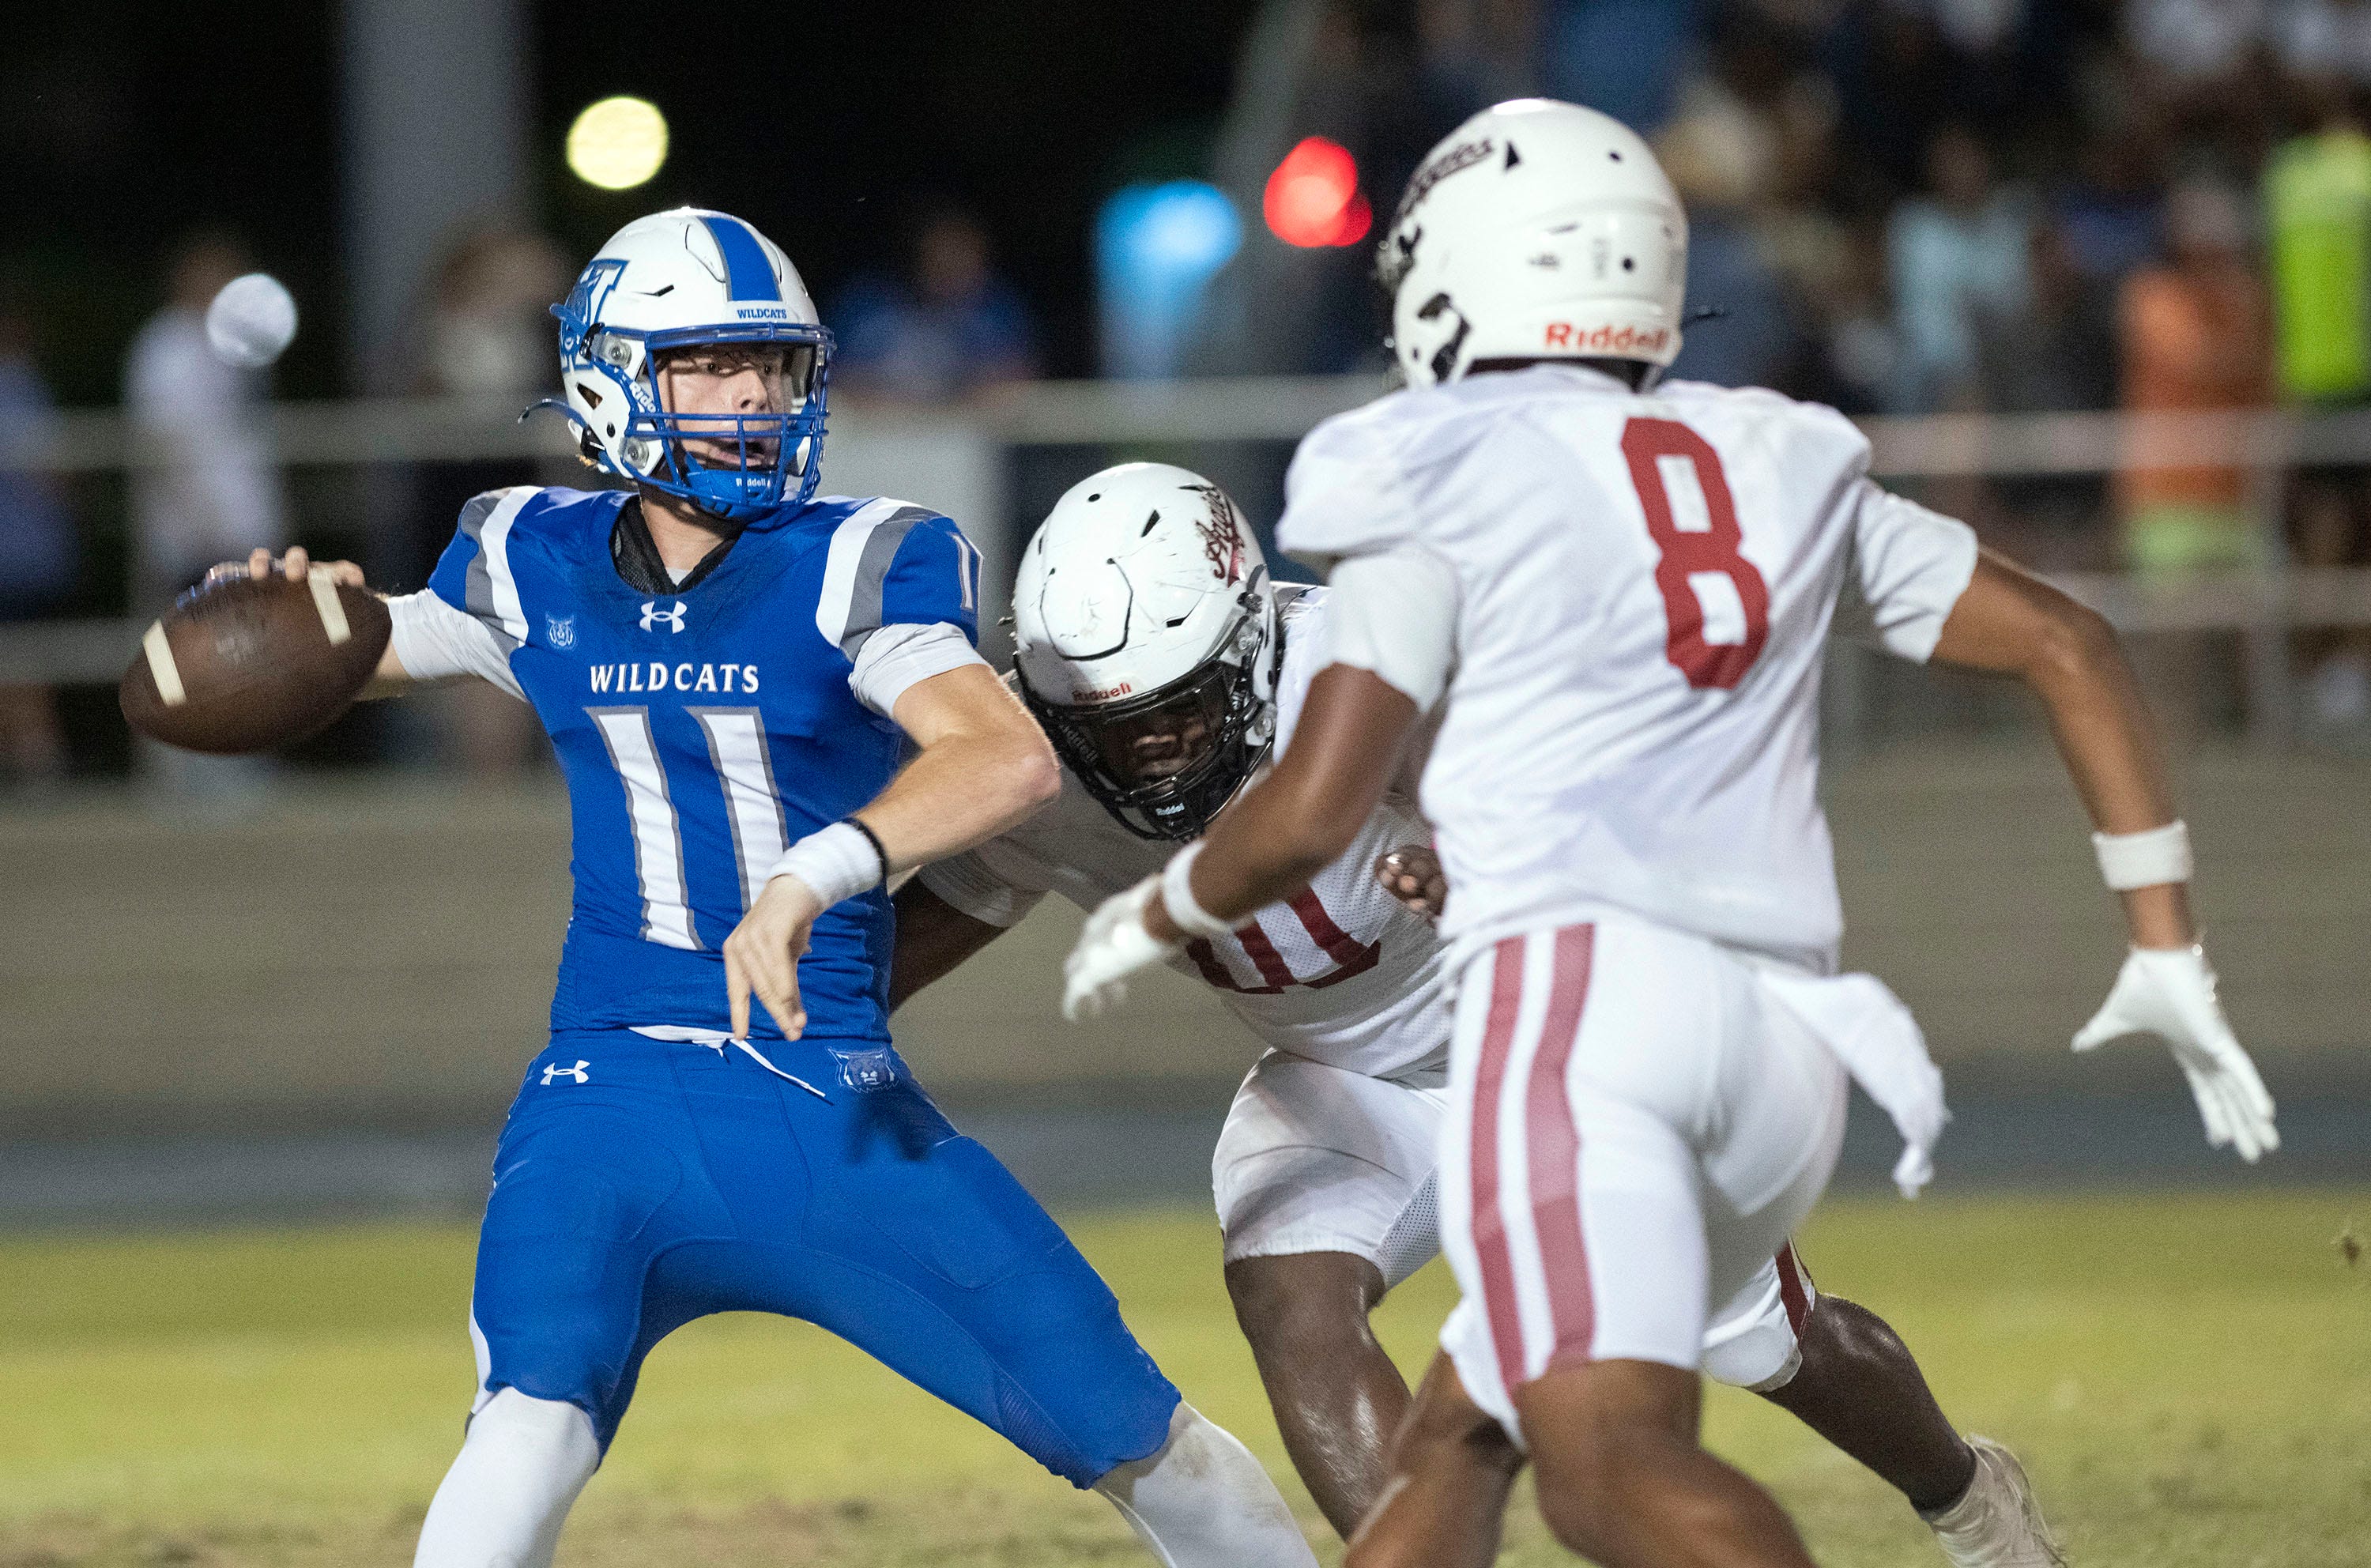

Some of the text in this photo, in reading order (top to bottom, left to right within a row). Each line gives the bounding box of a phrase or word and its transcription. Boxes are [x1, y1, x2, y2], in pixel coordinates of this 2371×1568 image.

[737, 308, 787, 318] WILDCATS
[736, 477, 766, 487] Rddell
[1620, 416, 1769, 690] 8
[590, 662, 760, 694] WILDCATS
[582, 705, 790, 951] 11
